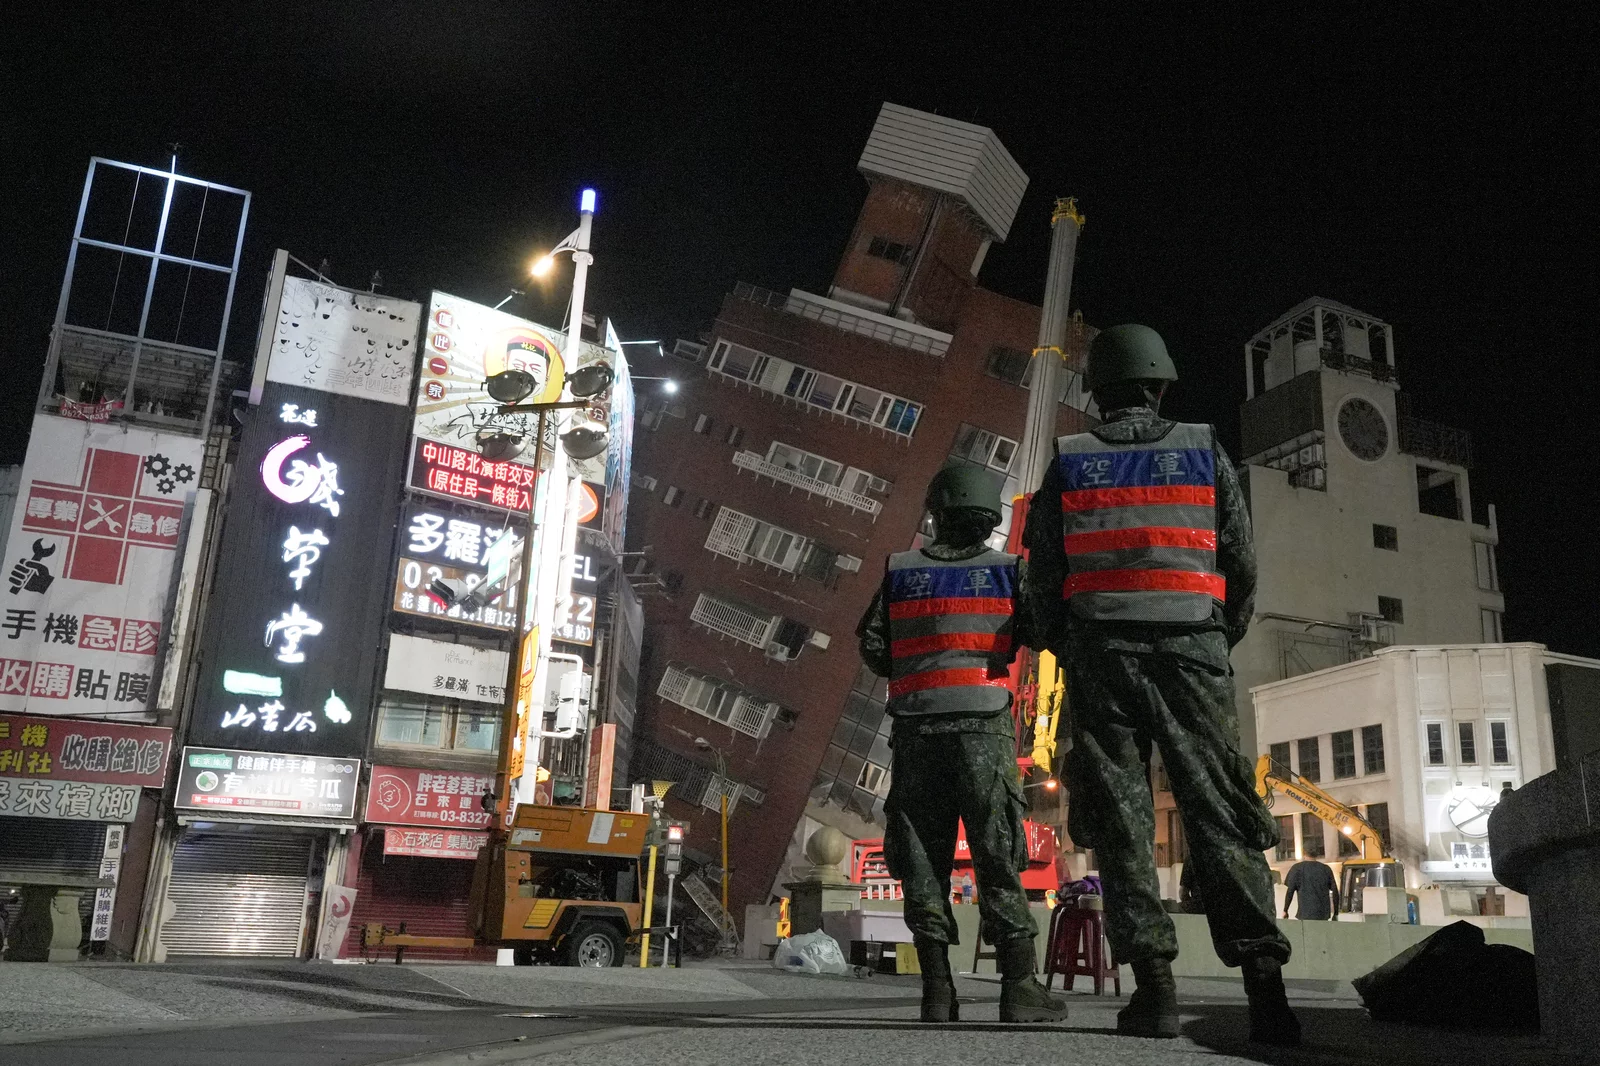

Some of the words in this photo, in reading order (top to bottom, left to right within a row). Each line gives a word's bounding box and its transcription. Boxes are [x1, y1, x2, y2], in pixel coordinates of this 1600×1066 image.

[279, 402, 319, 428] 花蓮
[423, 443, 543, 488] 中山路北濱街交叉
[1080, 452, 1186, 487] 空軍
[27, 496, 79, 522] 專業
[130, 512, 181, 537] 急修
[904, 567, 992, 599] 空軍
[2, 609, 159, 652] 手機急診
[0, 659, 151, 704] 收購貼膜
[433, 675, 471, 693] 多羅滿
[221, 700, 317, 732] 山苦瓜
[60, 734, 164, 774] 收購維修
[237, 755, 317, 775] 健康伴手禮
[415, 793, 484, 810] 石來運
[1285, 788, 1319, 813] KOMATSU
[440, 810, 492, 825] 03-8327
[404, 831, 444, 849] 石來店
[447, 834, 490, 850] 集點活
